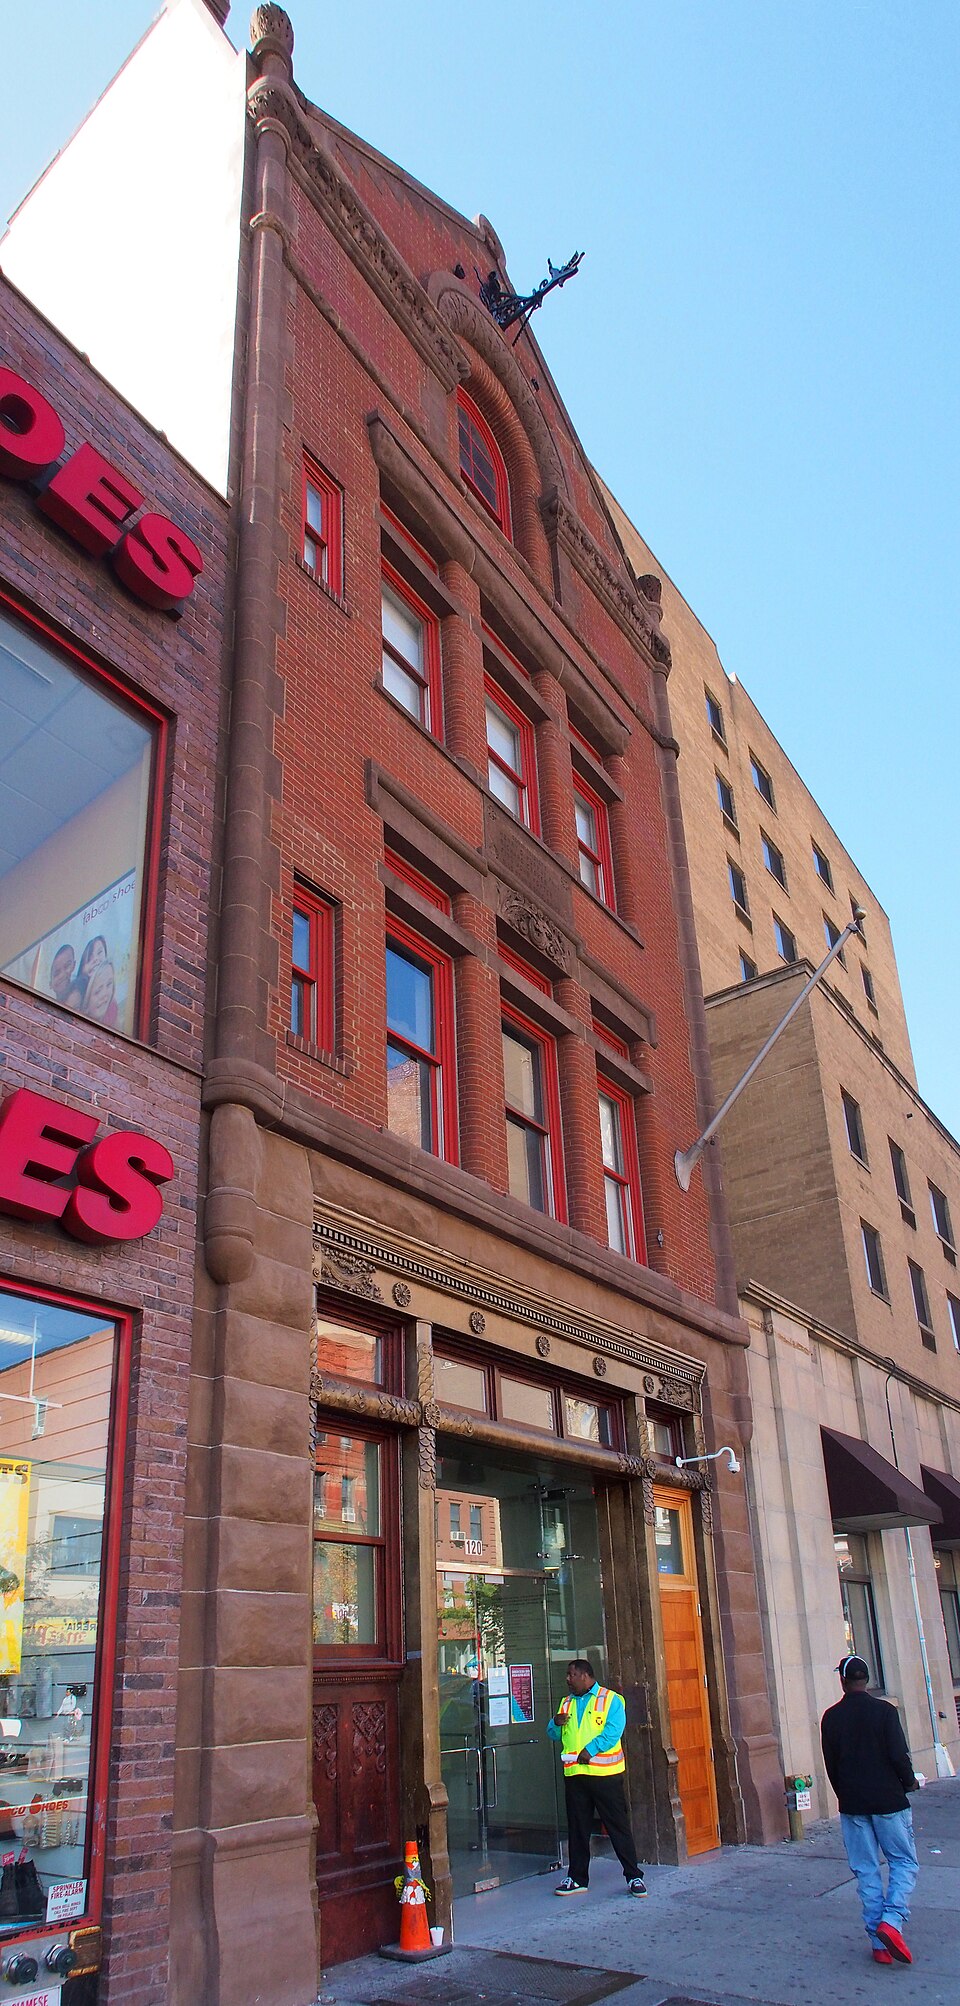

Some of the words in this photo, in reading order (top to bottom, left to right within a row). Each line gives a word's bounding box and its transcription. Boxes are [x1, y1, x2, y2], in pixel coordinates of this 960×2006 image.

[83, 900, 110, 926] fabco
[0, 1087, 174, 1240] ES
[466, 1540, 482, 1555] 120
[51, 1887, 84, 1899] FIRE-ALARM
[53, 1881, 83, 1892] SPRINKLER
[11, 1994, 48, 2006] MESE
